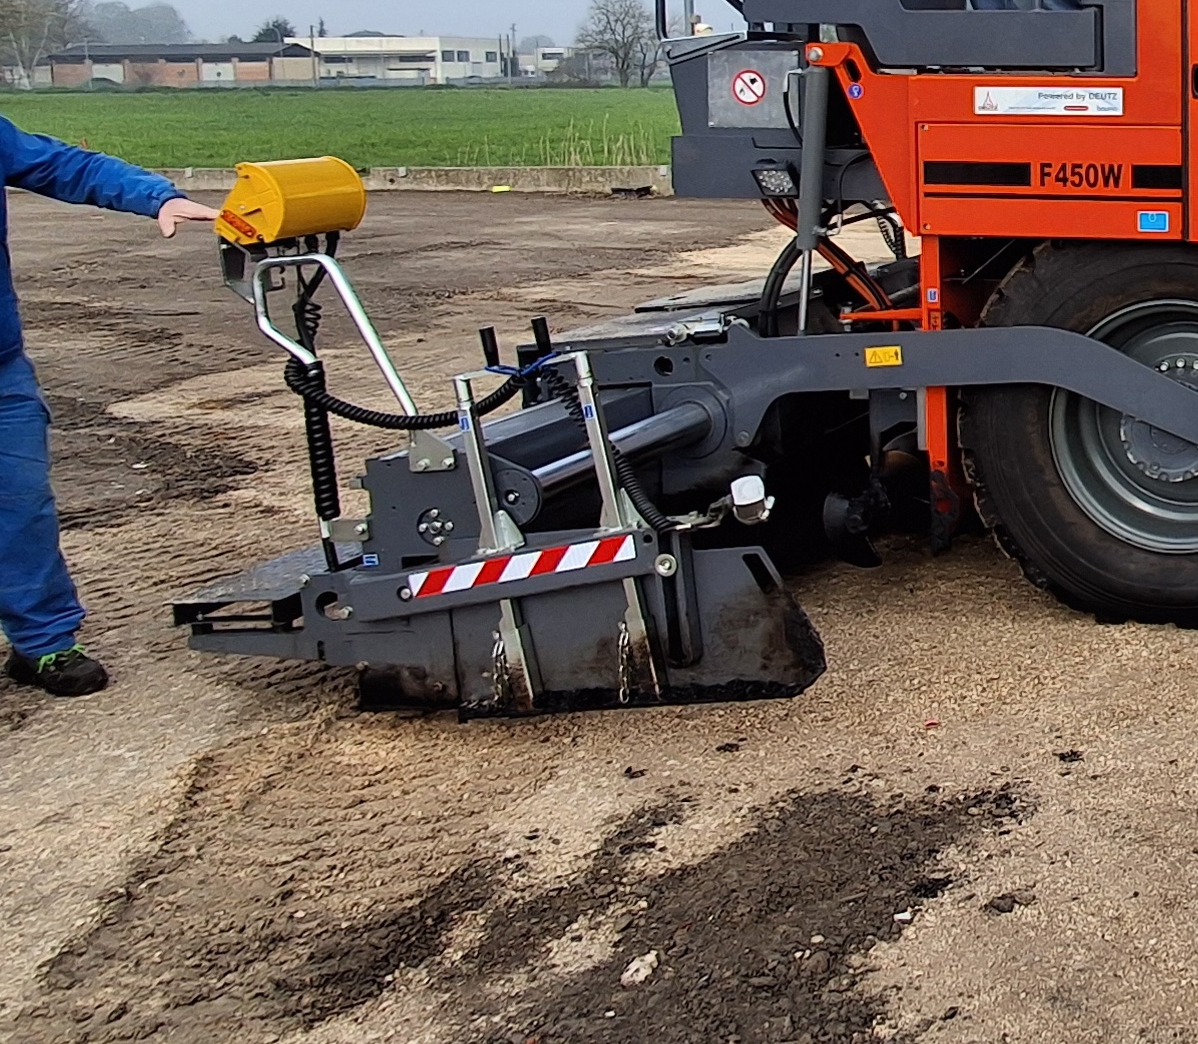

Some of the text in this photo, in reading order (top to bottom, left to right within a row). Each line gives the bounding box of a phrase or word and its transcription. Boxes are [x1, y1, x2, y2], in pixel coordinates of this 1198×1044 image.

[1038, 92, 1118, 102] Powered by DEUTZ
[1039, 162, 1123, 188] F450W
